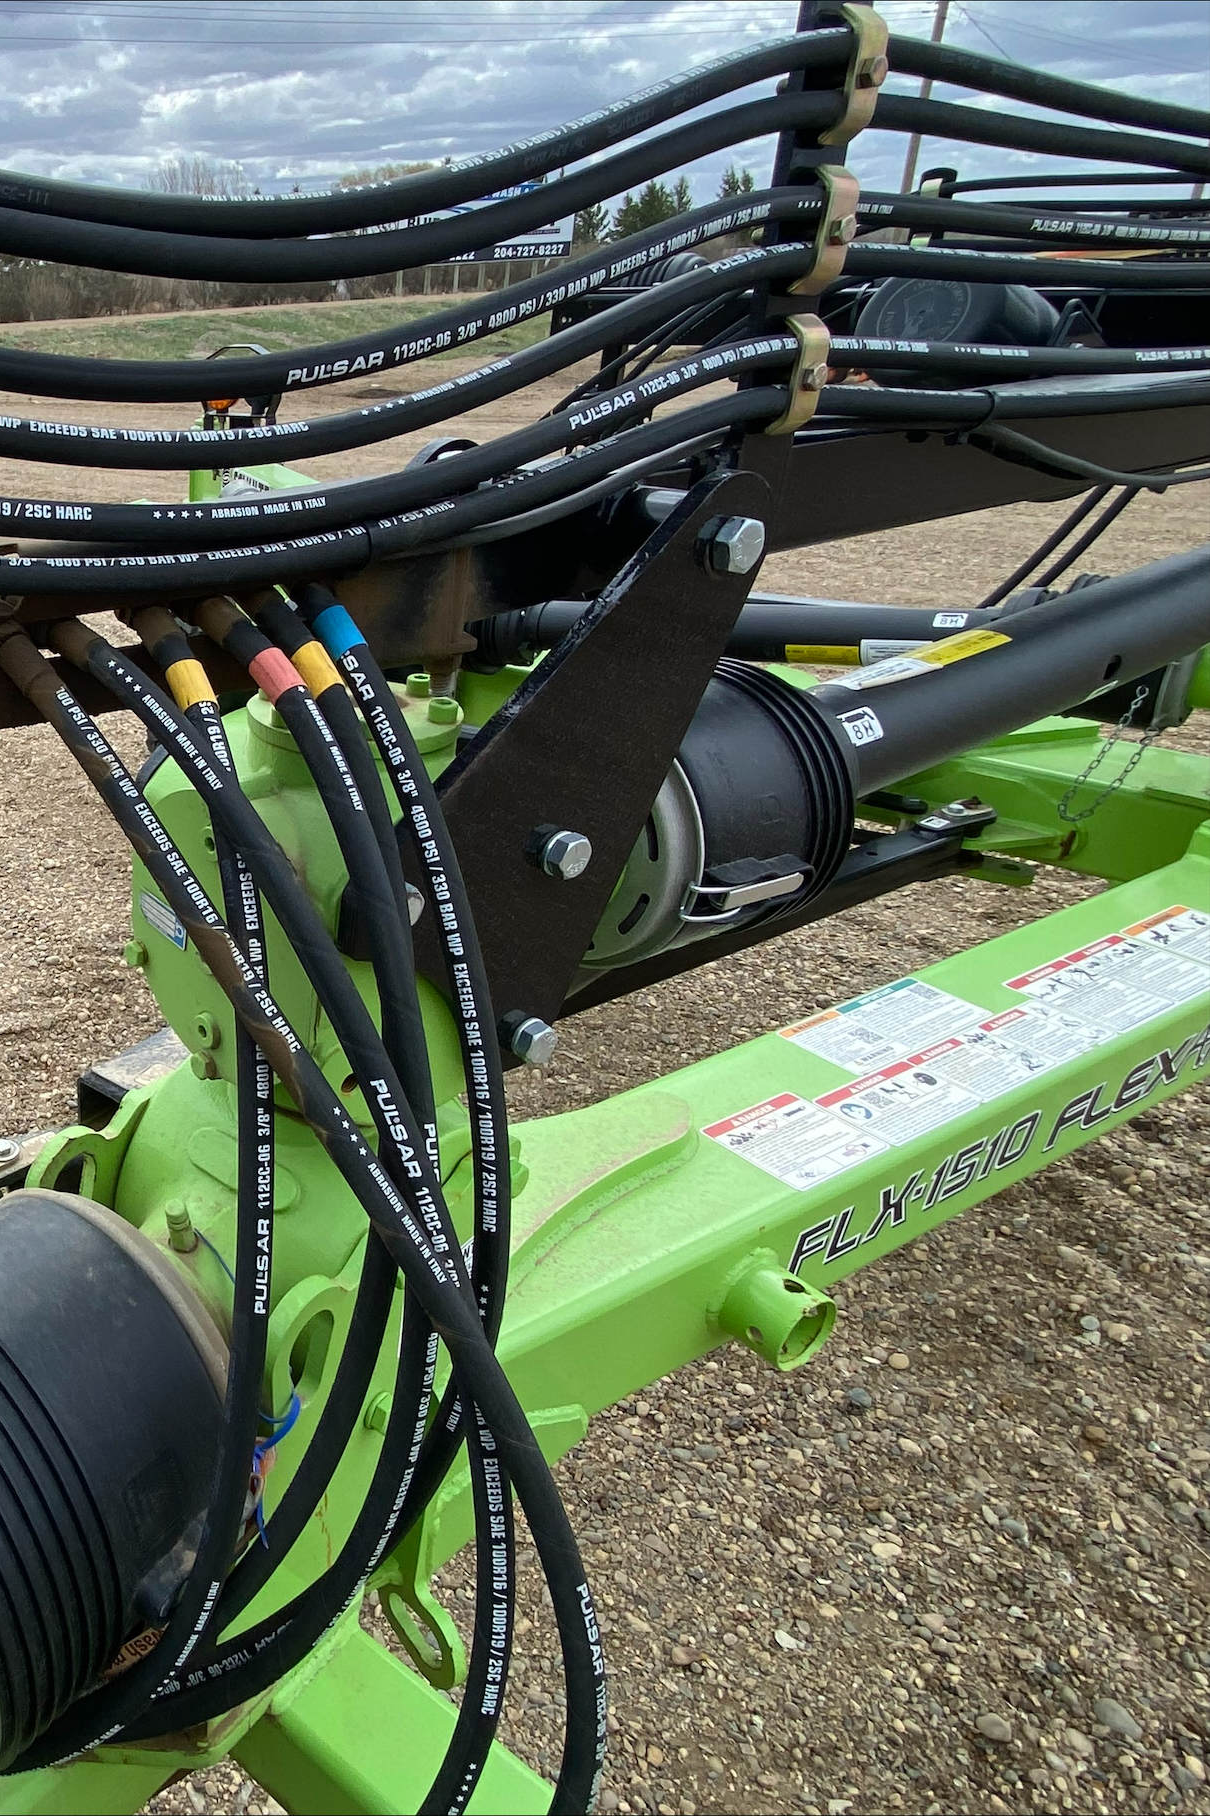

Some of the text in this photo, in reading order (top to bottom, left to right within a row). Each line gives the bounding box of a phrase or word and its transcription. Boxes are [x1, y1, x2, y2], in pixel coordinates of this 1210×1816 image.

[1030, 218, 1075, 233] PULSAR
[707, 247, 768, 274] PULSAR
[286, 207, 753, 386] PULSAR 112CC-06 3/8" 4800 PSI 330 BAR WP EXCEEDS SAE 100R16 2SC
[410, 372, 482, 402] ABRASION MADE
[567, 348, 735, 431] PULSAR 112CC-06 3/8" 4800 PSI
[29, 420, 88, 439] EXCEEDS
[90, 426, 118, 441] SAE
[119, 429, 173, 443] 100R16
[183, 430, 236, 443] 100R19
[246, 426, 272, 441] 2SC
[274, 420, 310, 437] HARC
[24, 503, 53, 519] 2SC
[55, 505, 93, 521] HARC
[211, 496, 327, 520] ABRASION MADE IN ITALY
[141, 693, 225, 792] ABRASION MADE IN ITALY
[303, 698, 365, 812] ABRASION MADE IN ITALY
[67, 704, 90, 727] PSI
[86, 730, 109, 756] 330
[102, 754, 126, 780] BAR
[118, 778, 141, 800] WP
[134, 801, 174, 853] EXCEEDS
[166, 850, 189, 878] SAE
[182, 876, 220, 925] 100R16
[254, 989, 278, 1018] 2SC
[271, 1017, 303, 1055] HARC
[239, 871, 260, 932] EXCEEDS
[248, 937, 264, 963] WP
[370, 704, 498, 1234] 112CC-06 3/8" 4800 PSI 330 BAR WP EXCEEDS SAE 100R16 100R19 2SC HARC
[255, 1062, 270, 1100] 4800
[854, 1074, 886, 1092] DANGER
[256, 1107, 272, 1138] 3/8"
[739, 1104, 776, 1125] DANGER
[256, 1143, 272, 1210] 112CC-06
[369, 1078, 450, 1254] PULSAR 112CC-06
[788, 1108, 1043, 1276] FLX-1510
[367, 1162, 448, 1285] ABRASION MADE IN ITALY
[253, 1218, 271, 1315] PULSAR
[479, 1429, 498, 1453] WP
[482, 1456, 505, 1513] EXCEEDS
[490, 1514, 506, 1540] SAE
[491, 1541, 508, 1597] 100R16
[194, 1580, 221, 1632] MADE ITALY
[490, 1601, 508, 1650] 100R19
[576, 1581, 605, 1676] PULSAR
[486, 1657, 504, 1686] 2SC
[480, 1684, 502, 1717] HARC
